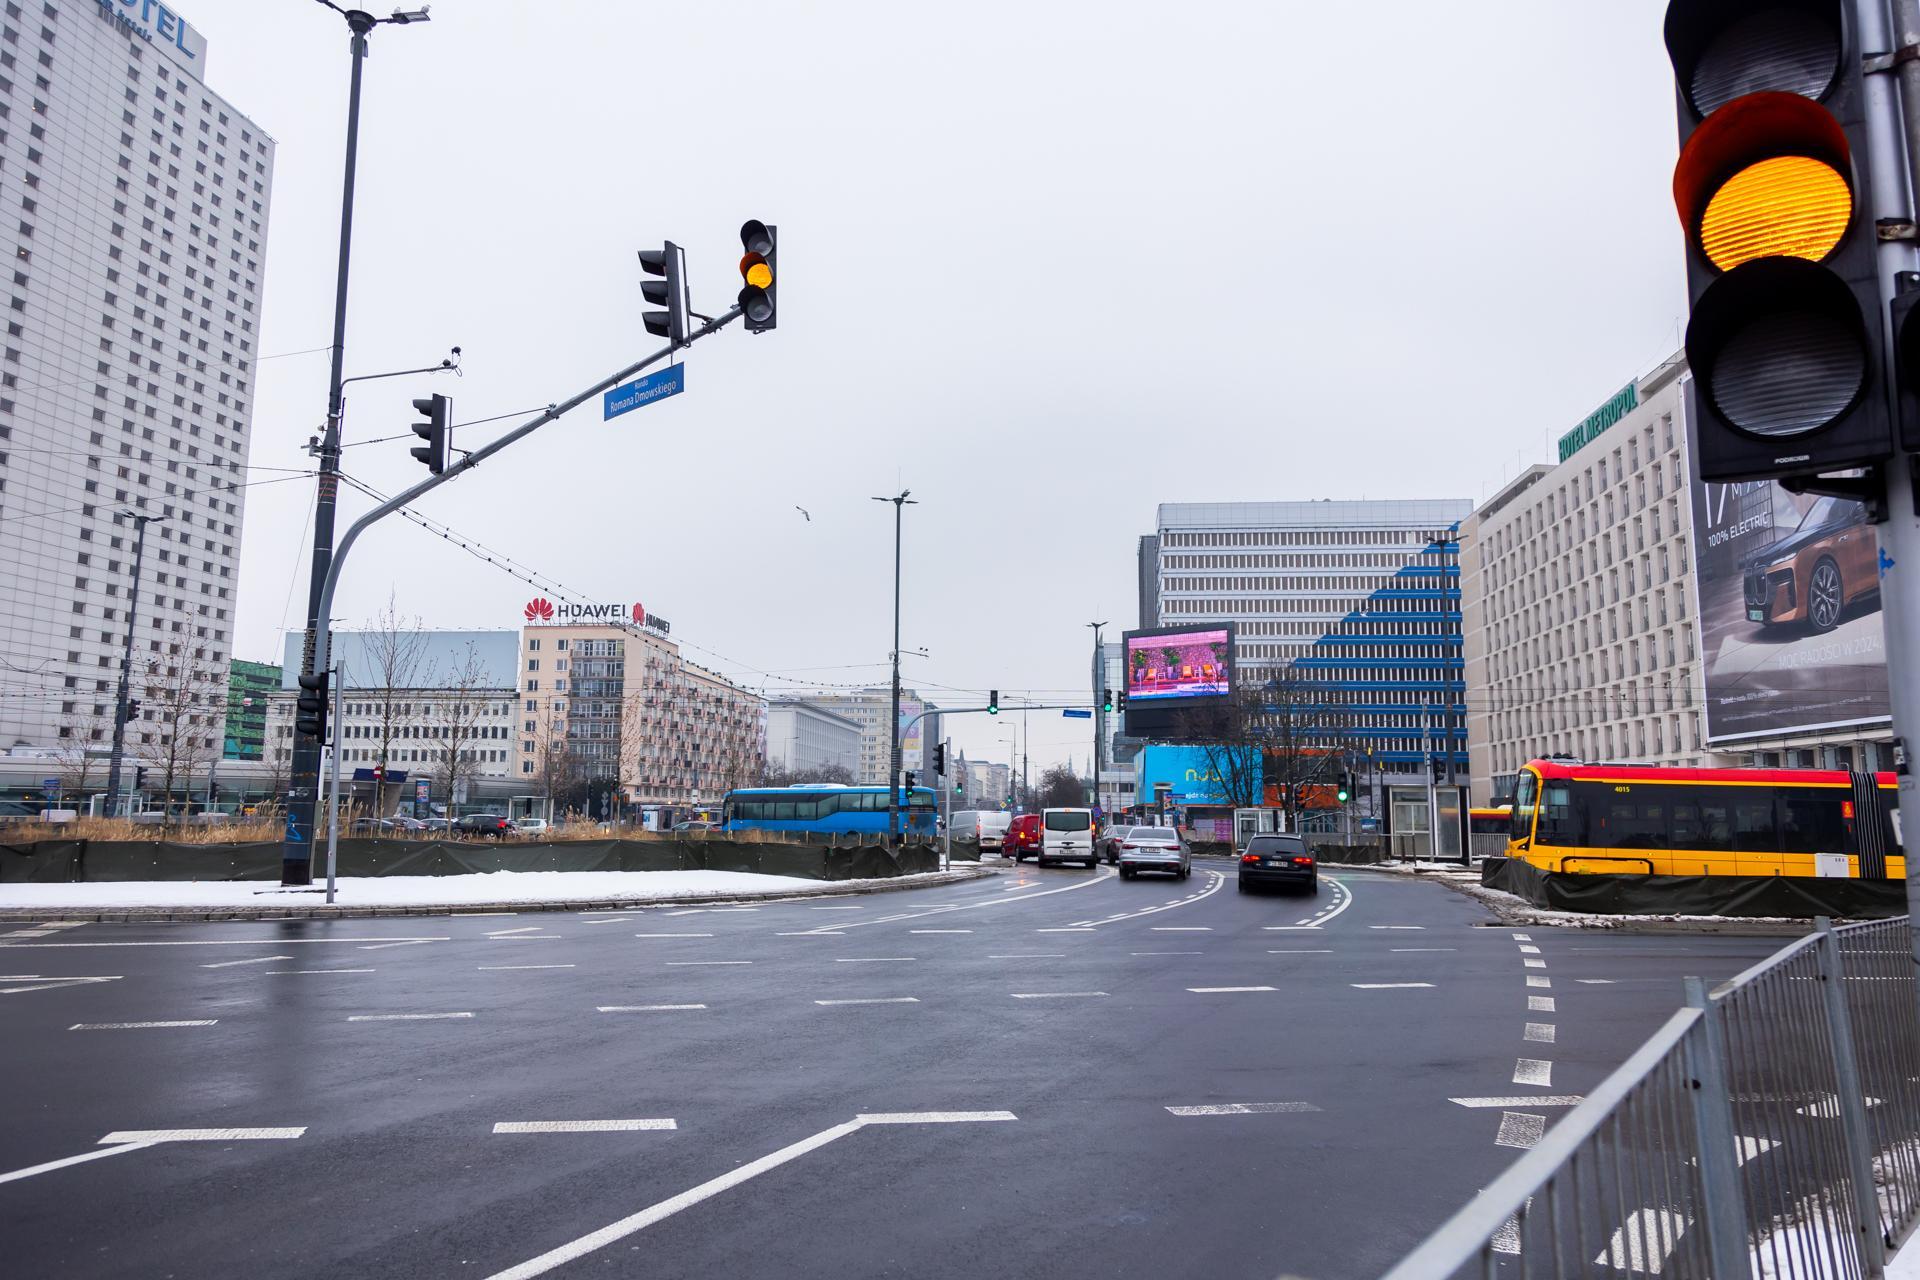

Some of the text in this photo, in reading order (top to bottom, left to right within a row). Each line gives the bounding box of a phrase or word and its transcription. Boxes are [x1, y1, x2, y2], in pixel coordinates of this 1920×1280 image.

[119, 0, 195, 59] TEL
[610, 381, 677, 413] Romana Dmowskiego
[1586, 384, 1638, 442] METROPOL
[1708, 512, 1768, 548] 100% ELECTRIC
[558, 605, 626, 617] HUAWEI
